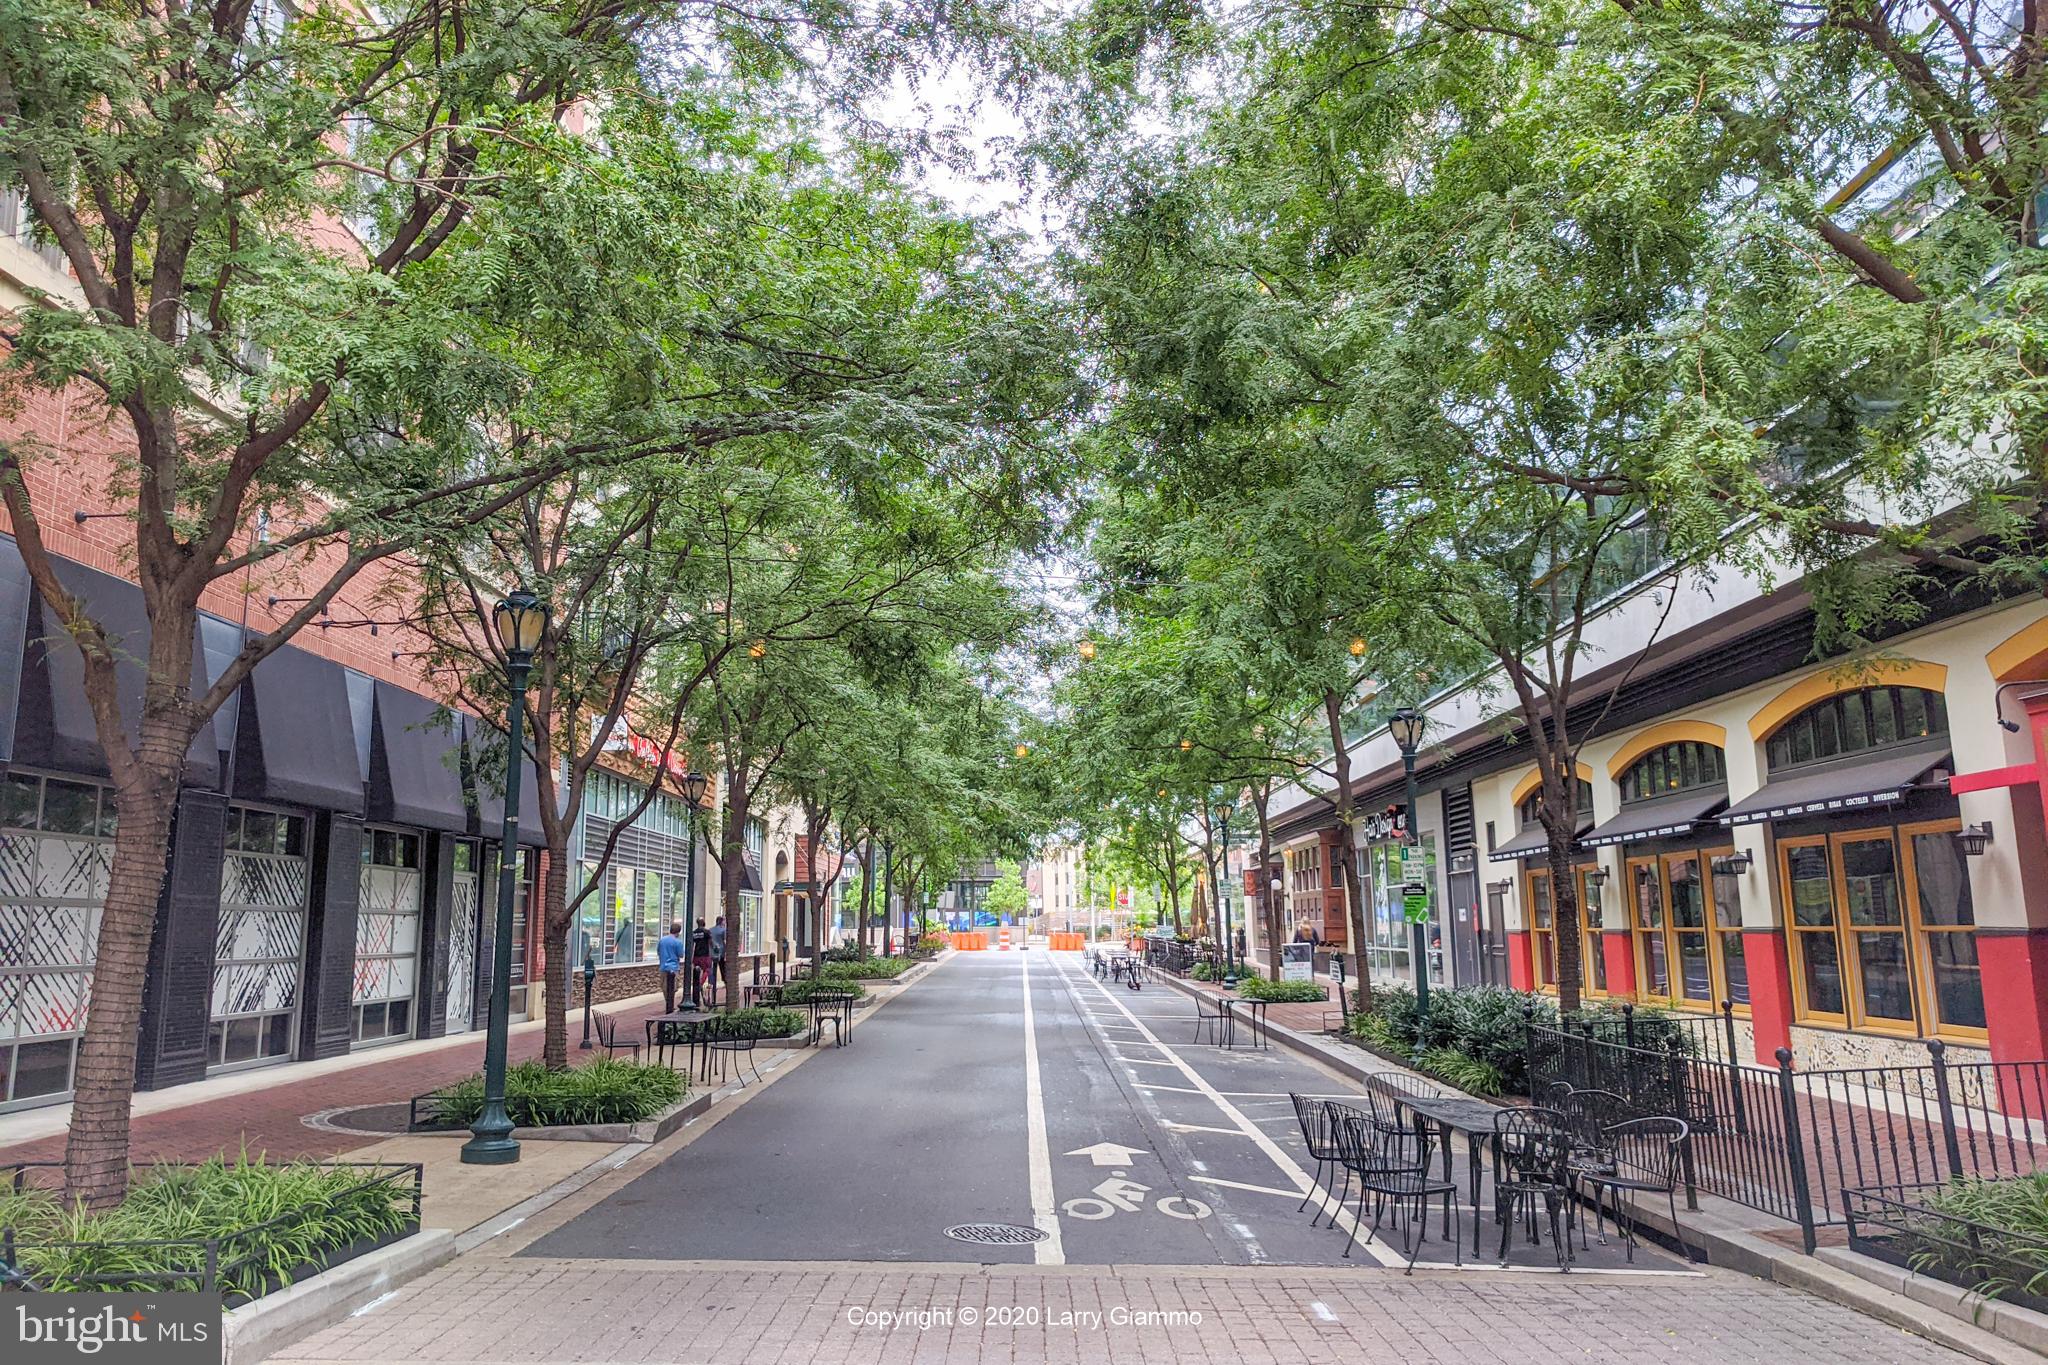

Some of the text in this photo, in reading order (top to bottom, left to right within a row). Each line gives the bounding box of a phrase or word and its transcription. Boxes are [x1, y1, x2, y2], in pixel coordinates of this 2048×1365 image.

[1806, 802, 1825, 812] CERVEZA
[1845, 795, 1869, 806] COCTELES
[1873, 791, 1900, 803] DIVERSION
[1363, 818, 1376, 842] Hair
